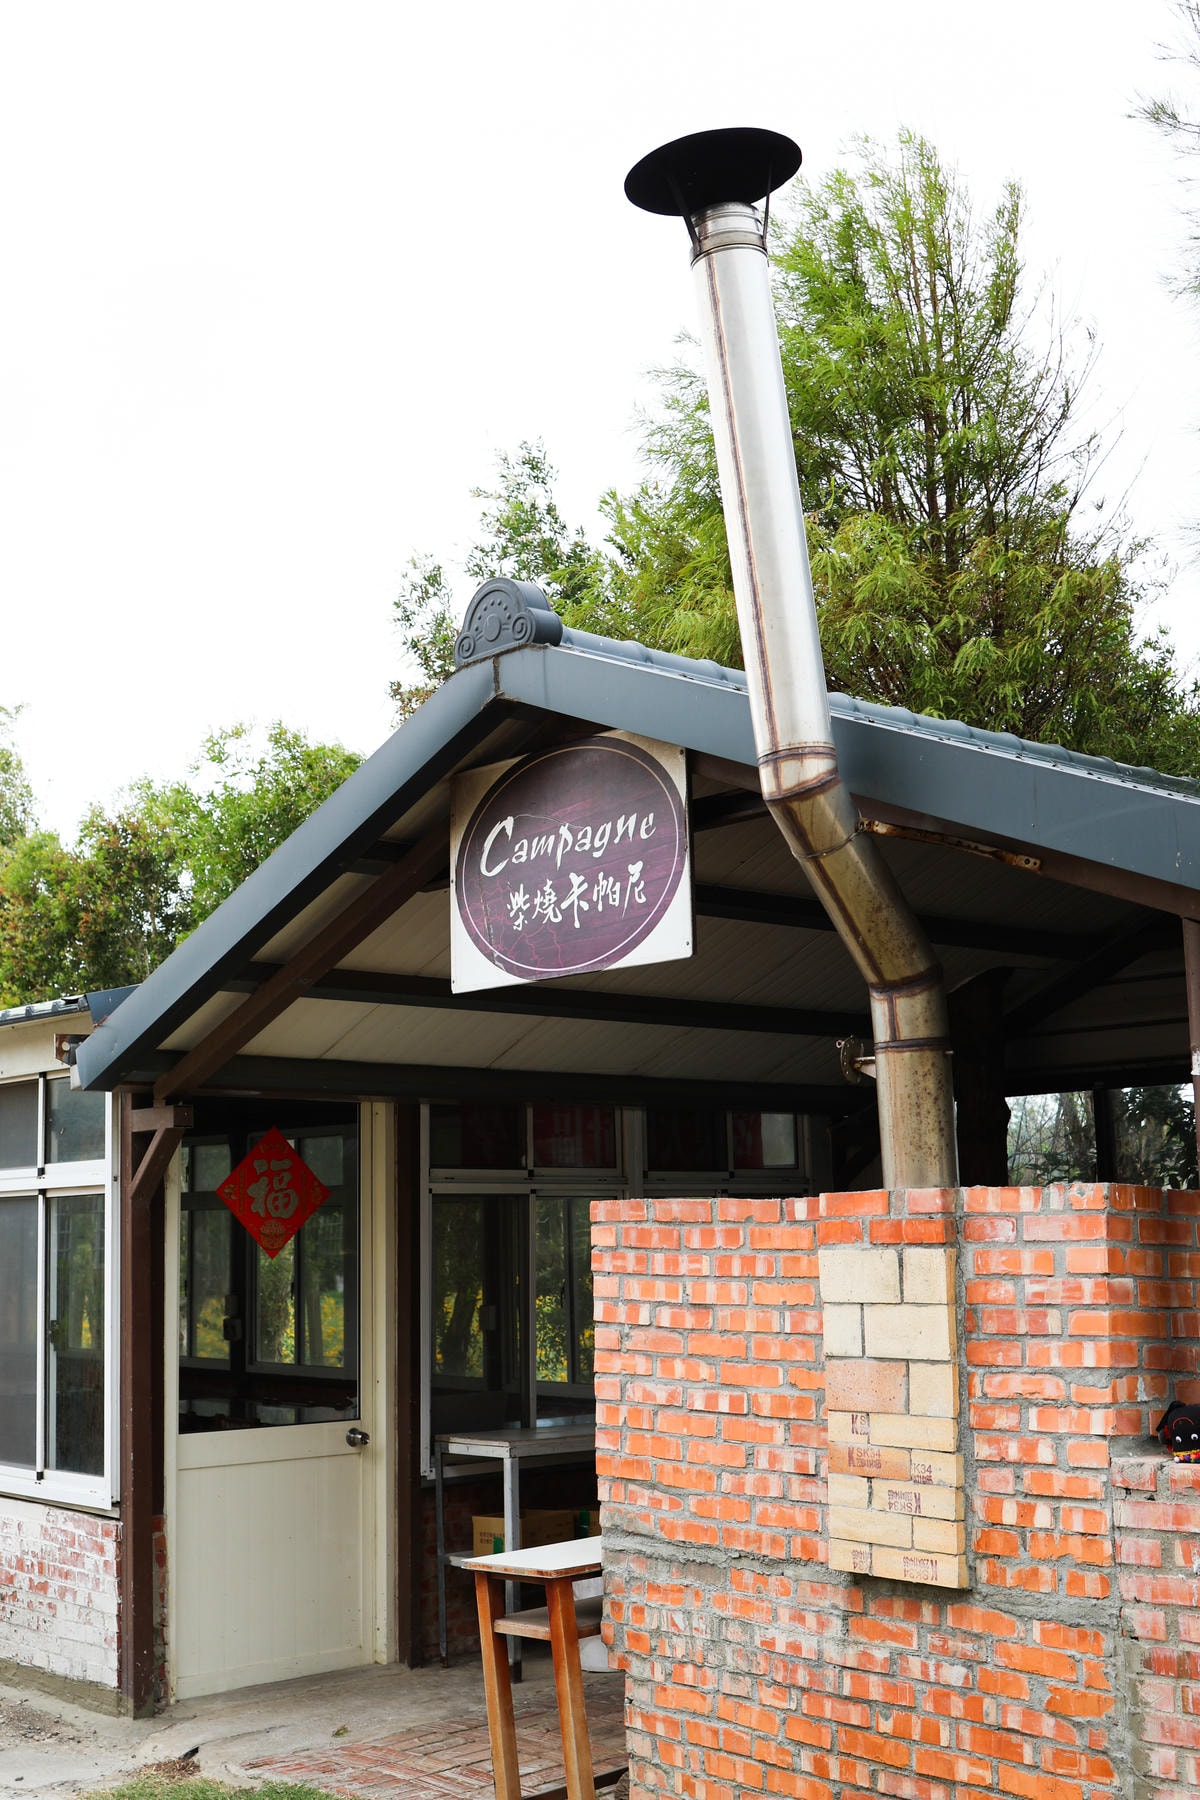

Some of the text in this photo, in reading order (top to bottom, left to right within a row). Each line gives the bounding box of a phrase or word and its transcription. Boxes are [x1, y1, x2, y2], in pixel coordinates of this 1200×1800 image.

[480, 812, 657, 877] Campagne
[506, 860, 647, 931] 柴燒卡帕尼
[247, 1158, 300, 1219] 福
